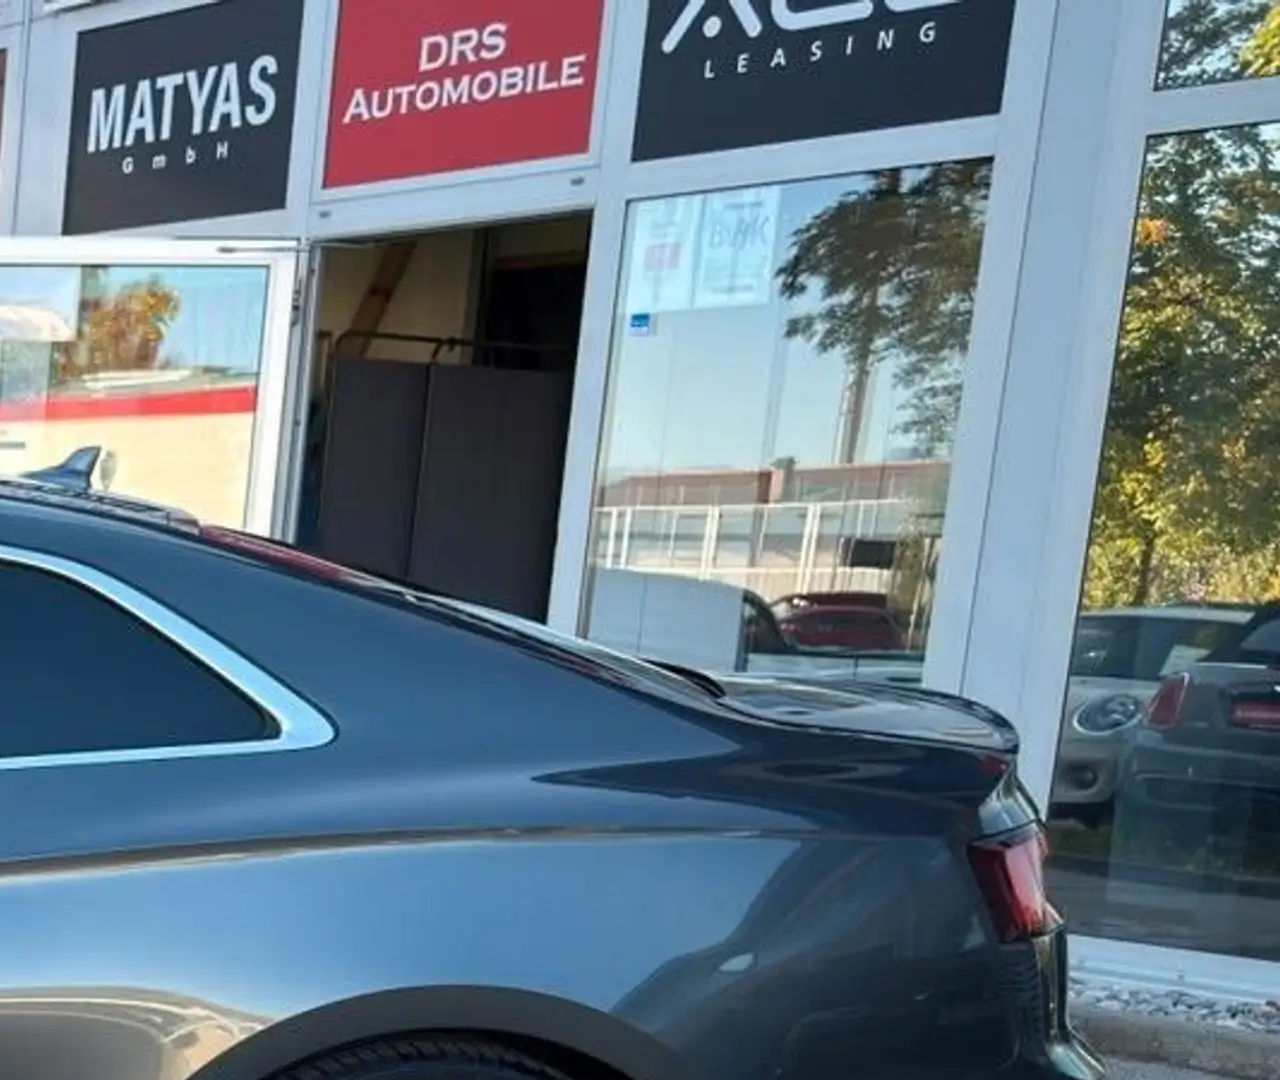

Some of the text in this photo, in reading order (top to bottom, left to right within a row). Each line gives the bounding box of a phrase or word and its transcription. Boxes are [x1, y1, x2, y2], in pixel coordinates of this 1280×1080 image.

[418, 22, 509, 73] DRS
[703, 21, 937, 80] LEASING
[87, 54, 279, 154] MATYAS
[342, 53, 588, 124] AUTOMOBILE
